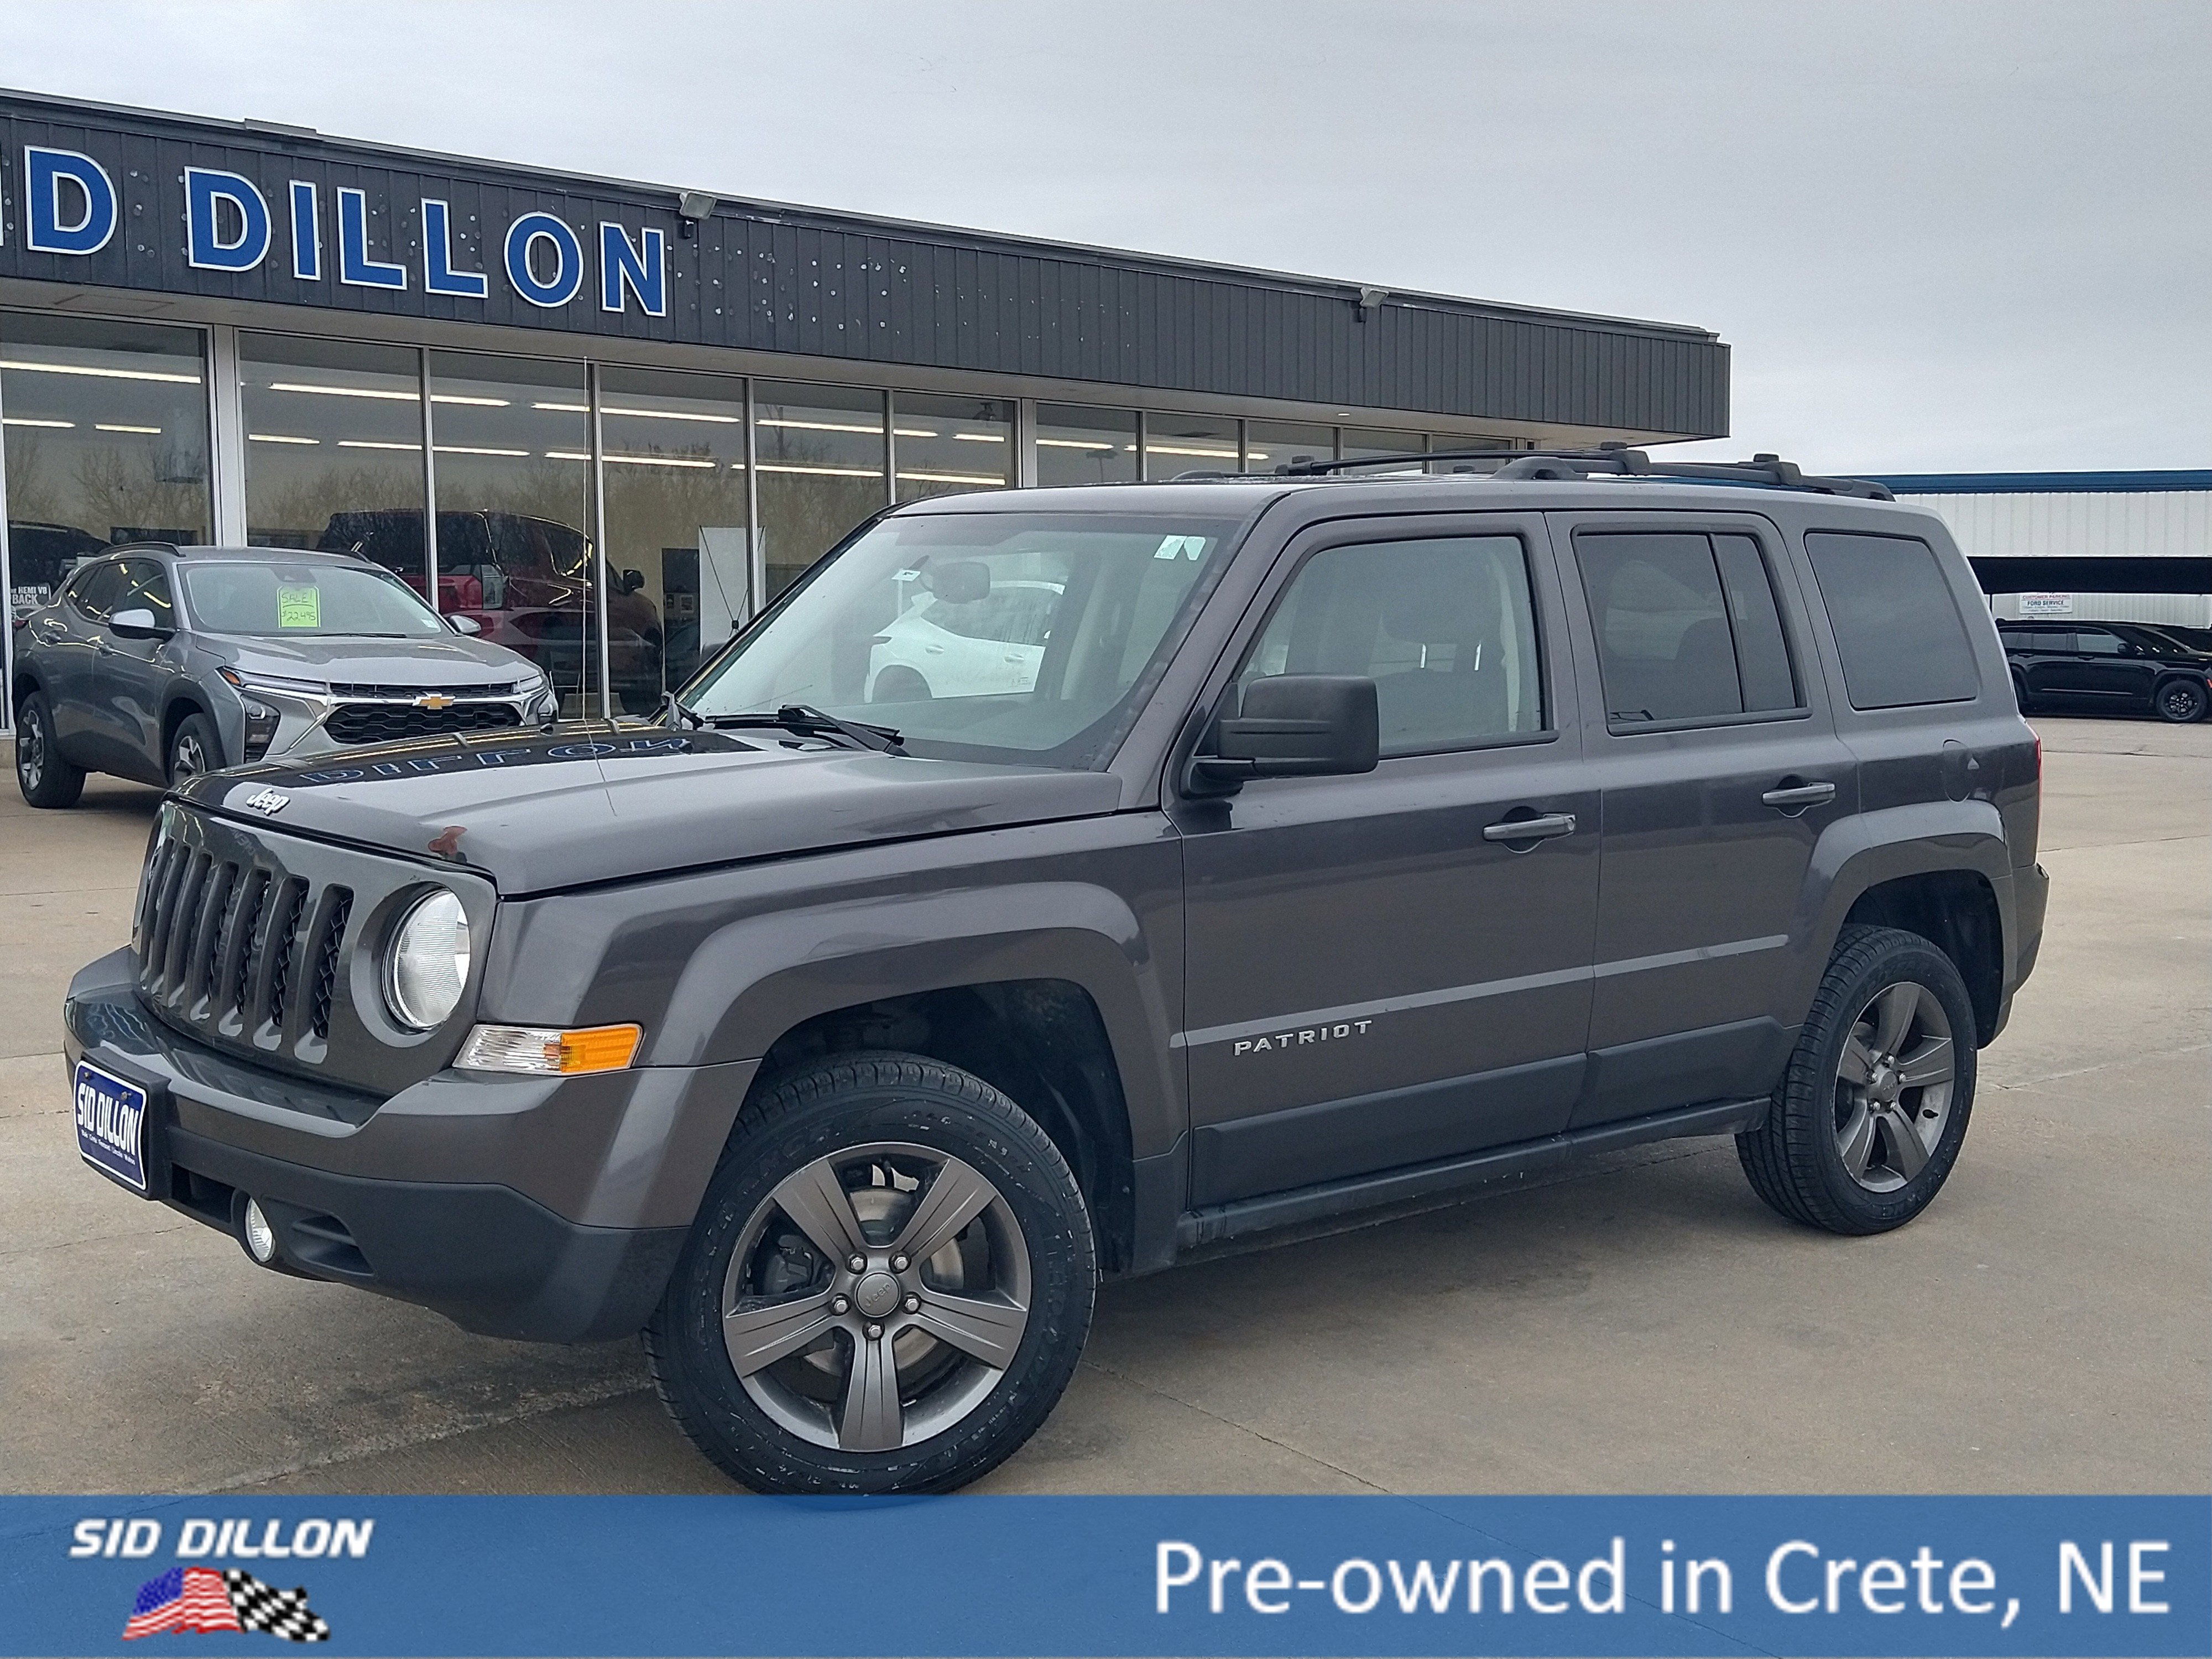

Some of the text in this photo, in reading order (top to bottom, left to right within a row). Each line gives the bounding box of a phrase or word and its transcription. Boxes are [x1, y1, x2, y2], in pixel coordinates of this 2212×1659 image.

[0, 145, 666, 317] D DILLON
[12, 594, 39, 604] BACK
[246, 787, 289, 816] Jeep
[1234, 1020, 1372, 1056] PATRIOT
[77, 1082, 139, 1156] SID DILLON
[865, 1283, 891, 1307] Jeep
